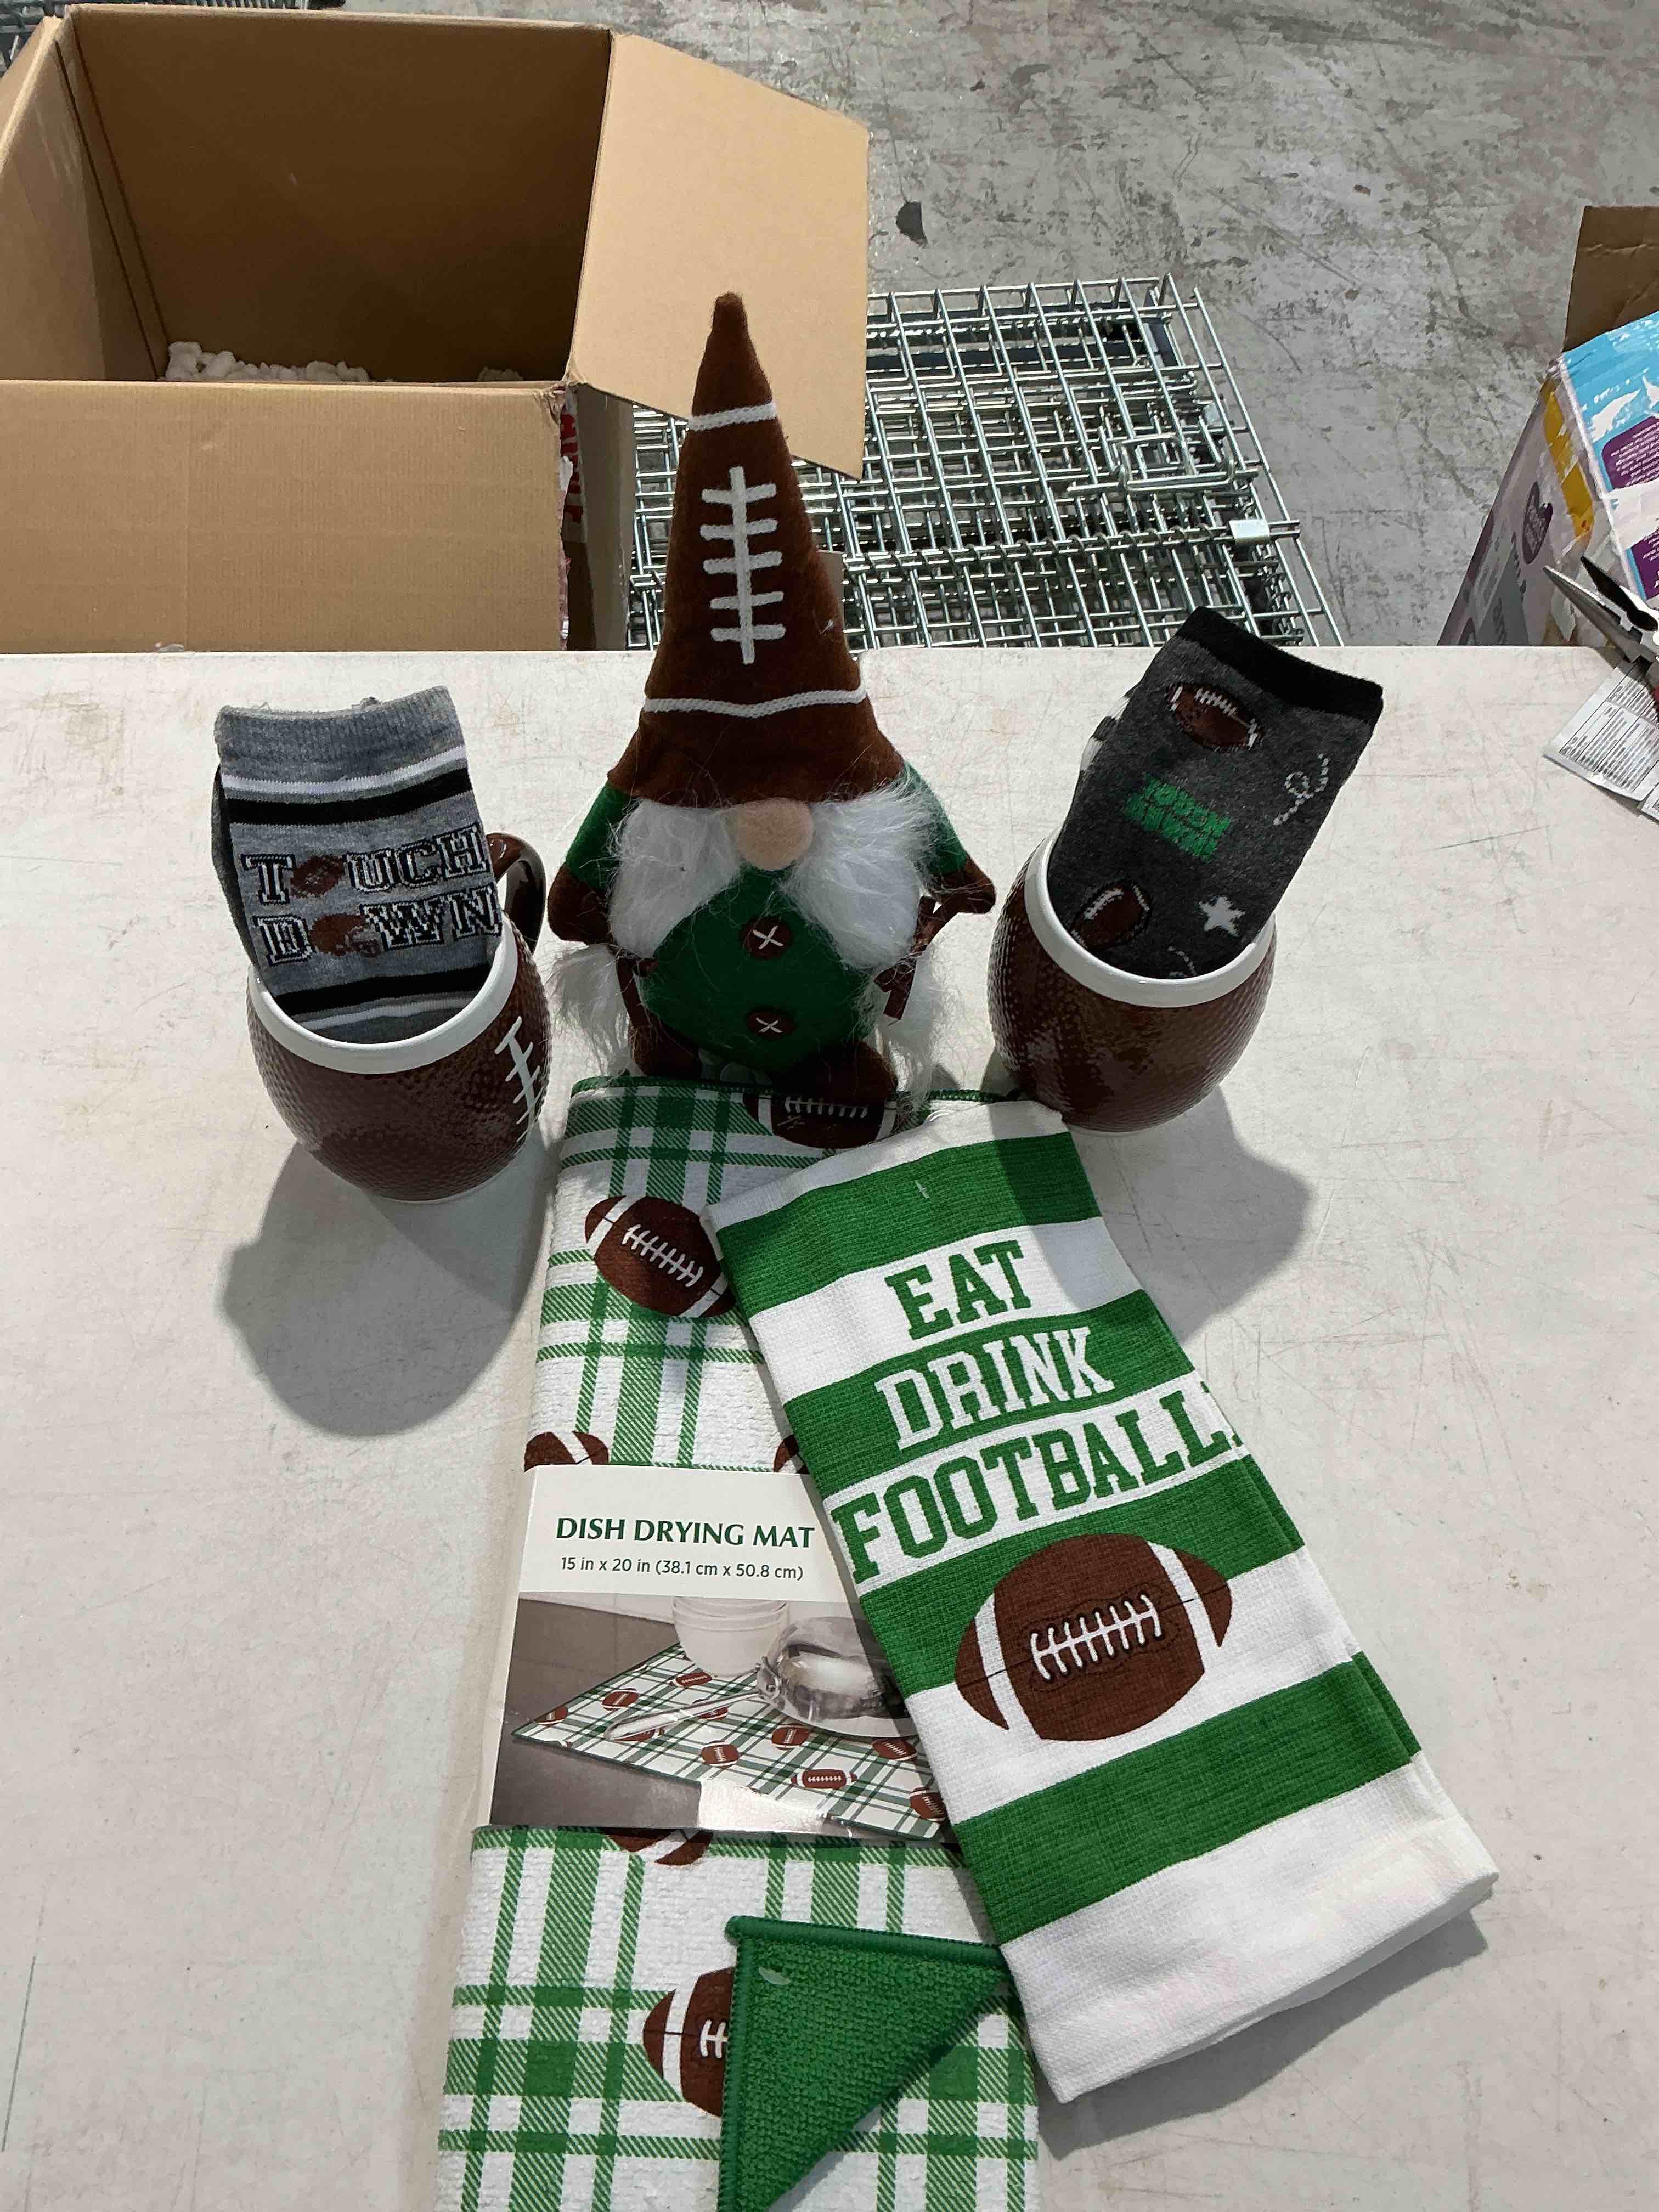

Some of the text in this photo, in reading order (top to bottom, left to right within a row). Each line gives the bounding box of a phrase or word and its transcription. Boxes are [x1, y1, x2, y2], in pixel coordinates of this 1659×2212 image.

[240, 825, 491, 905] TUCH
[252, 884, 503, 966] DWN
[884, 1239, 1031, 1340] EAT
[874, 1326, 1115, 1451] DRINK
[831, 1381, 1244, 1584] FOOTBALL
[556, 1517, 815, 1548] DISH DRYING MAT
[561, 1556, 804, 1581] 15 in x 20 in (38.1 cm x 50.8 cm)
